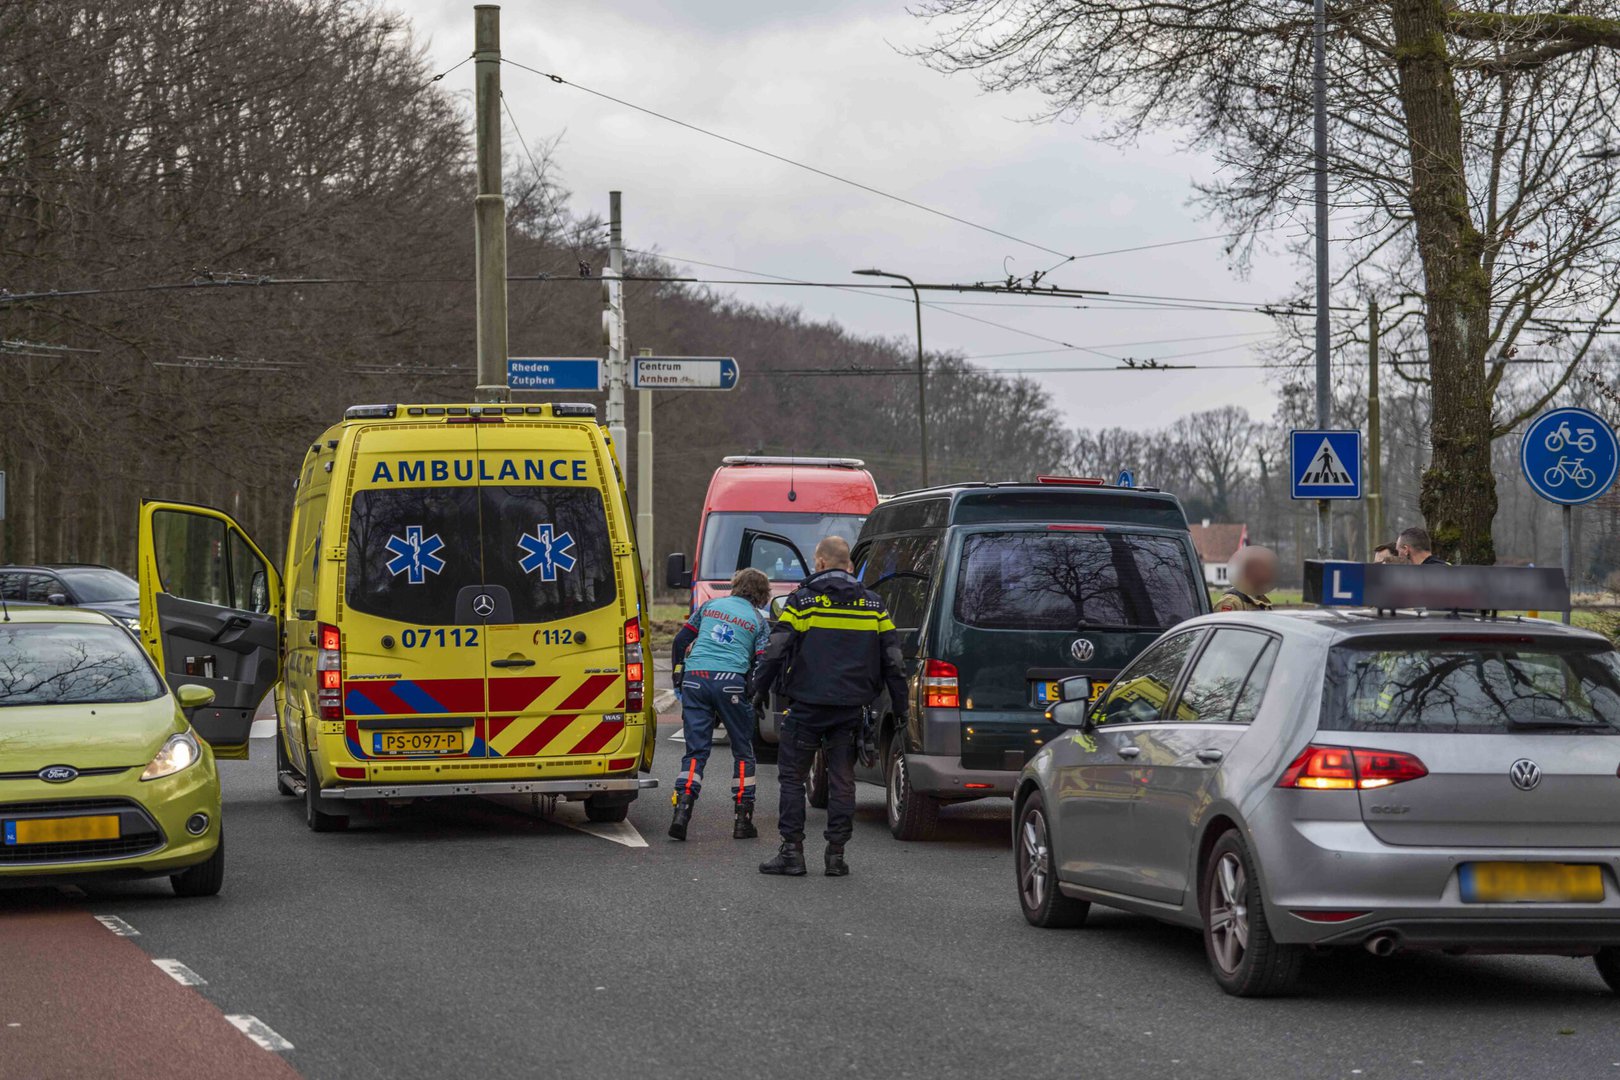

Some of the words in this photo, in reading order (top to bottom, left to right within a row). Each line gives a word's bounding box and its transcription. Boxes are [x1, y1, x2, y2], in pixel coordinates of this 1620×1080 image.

[511, 363, 550, 372] Rheden
[639, 361, 682, 370] Centrum
[511, 375, 555, 386] Zutphen
[639, 374, 678, 383] Arnhem
[371, 459, 588, 483] AMBULANCE
[1332, 569, 1353, 599] L
[702, 608, 756, 633] AMBULANCE
[401, 627, 479, 649] 07112
[386, 734, 456, 749] PS-097-P
[47, 769, 70, 779] Ford
